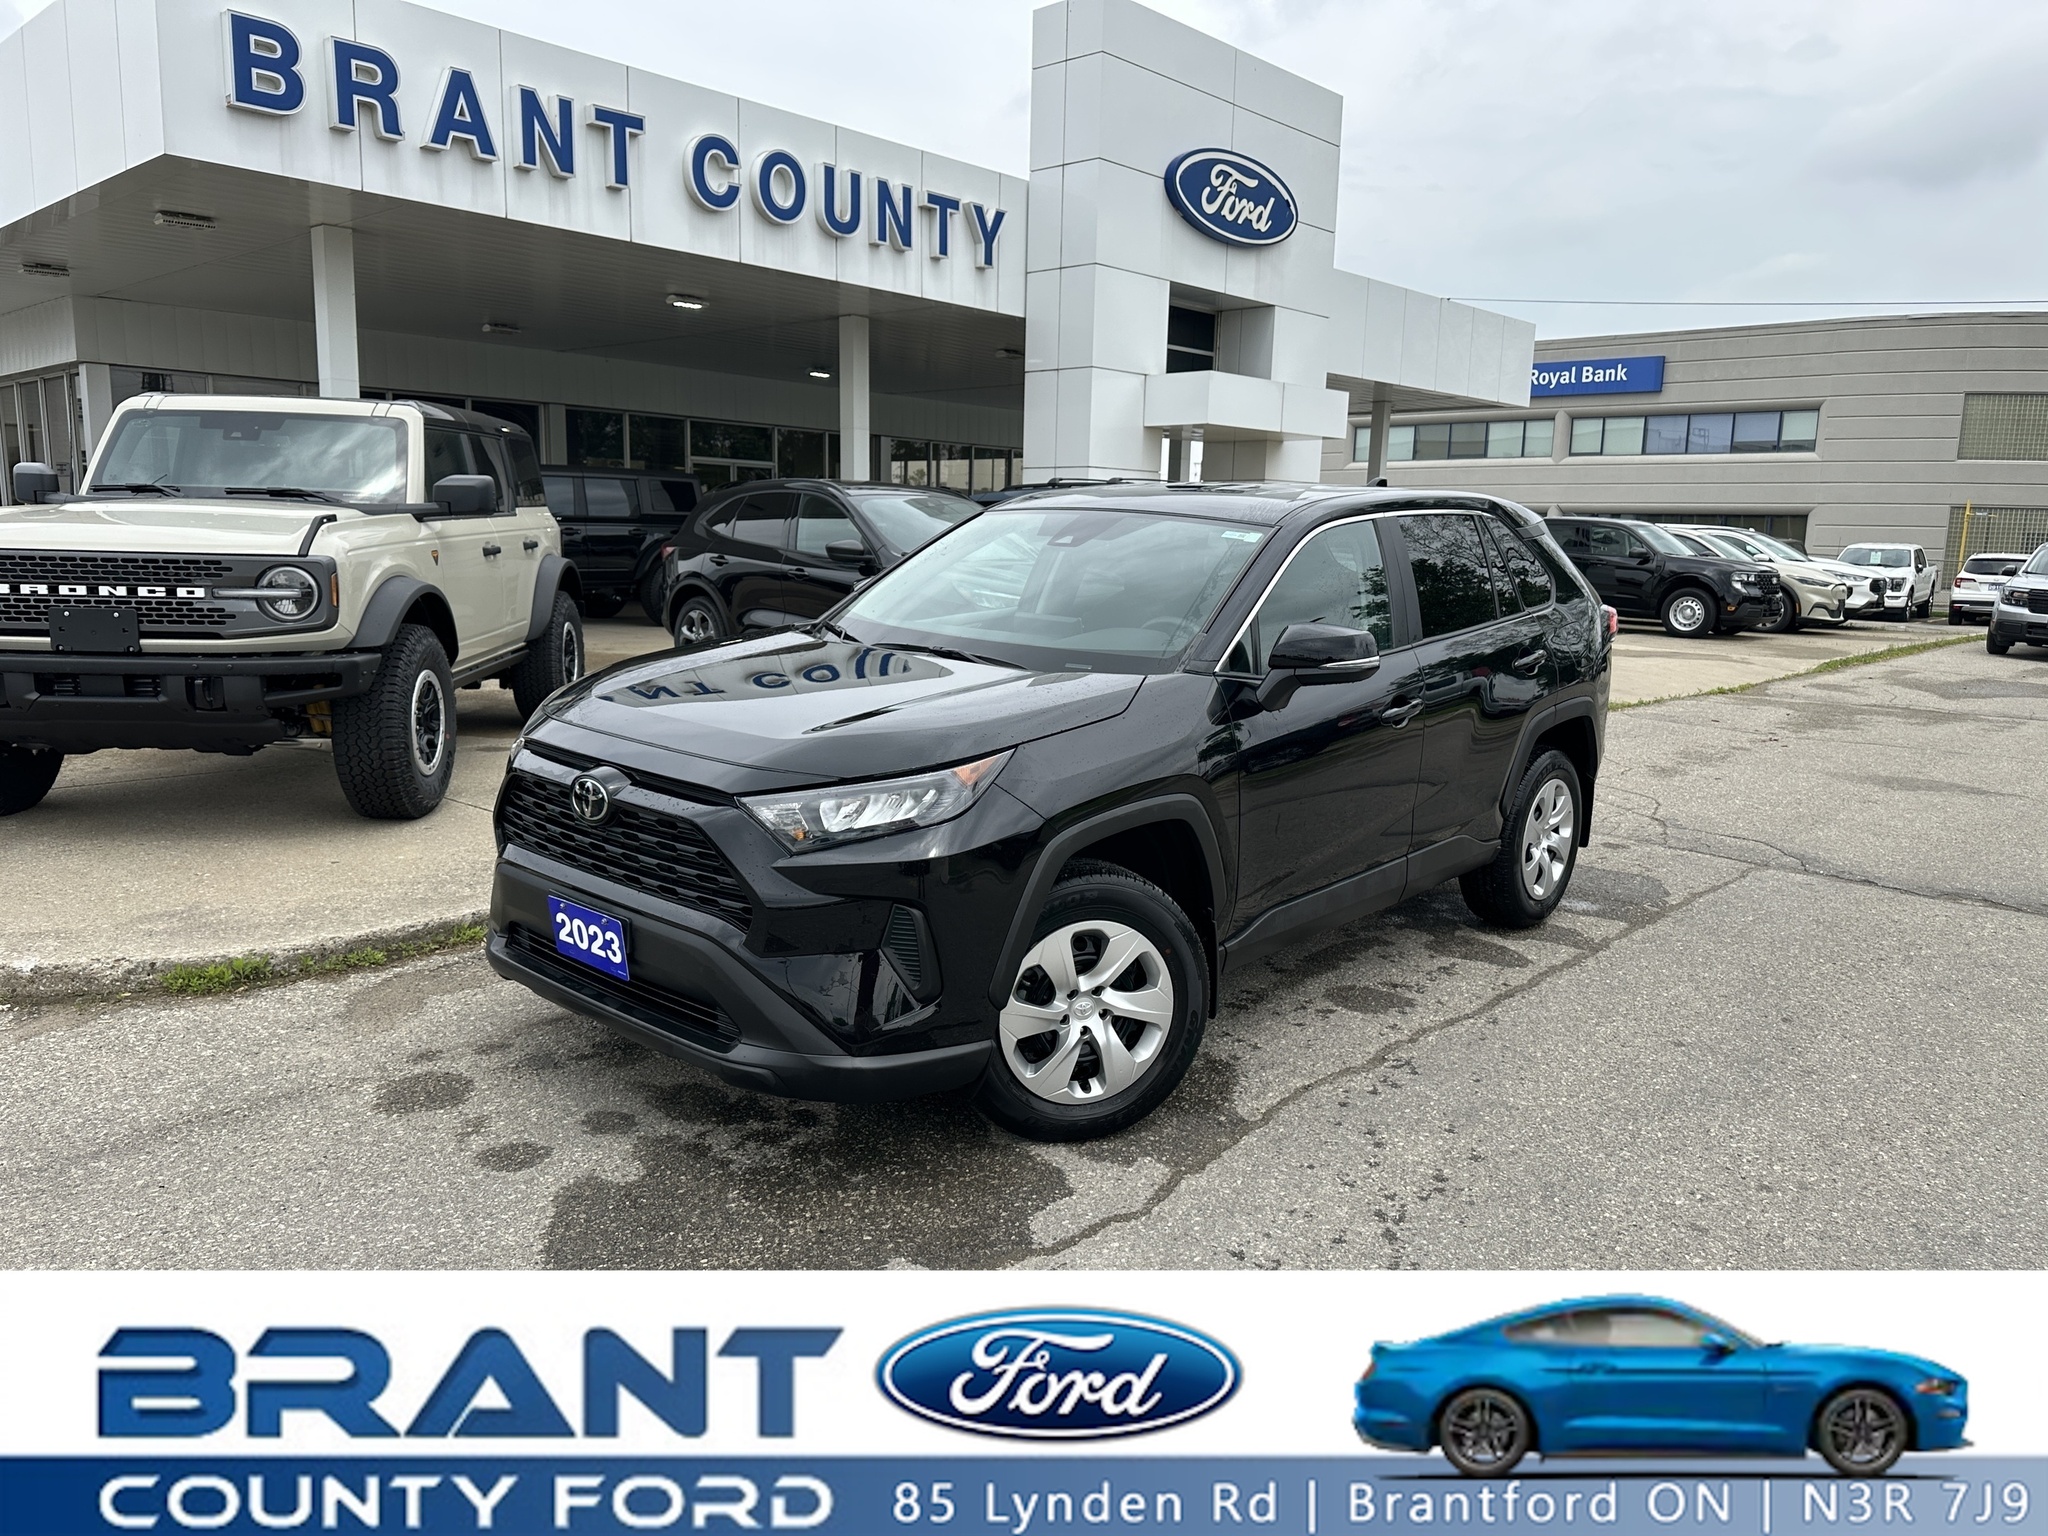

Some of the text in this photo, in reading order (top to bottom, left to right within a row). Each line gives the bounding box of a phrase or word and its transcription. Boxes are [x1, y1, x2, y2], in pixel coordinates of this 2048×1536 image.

[221, 9, 1008, 269] BRANT COUNTY
[1201, 163, 1275, 232] Ford
[1581, 363, 1628, 383] Bank
[556, 912, 622, 964] 2023
